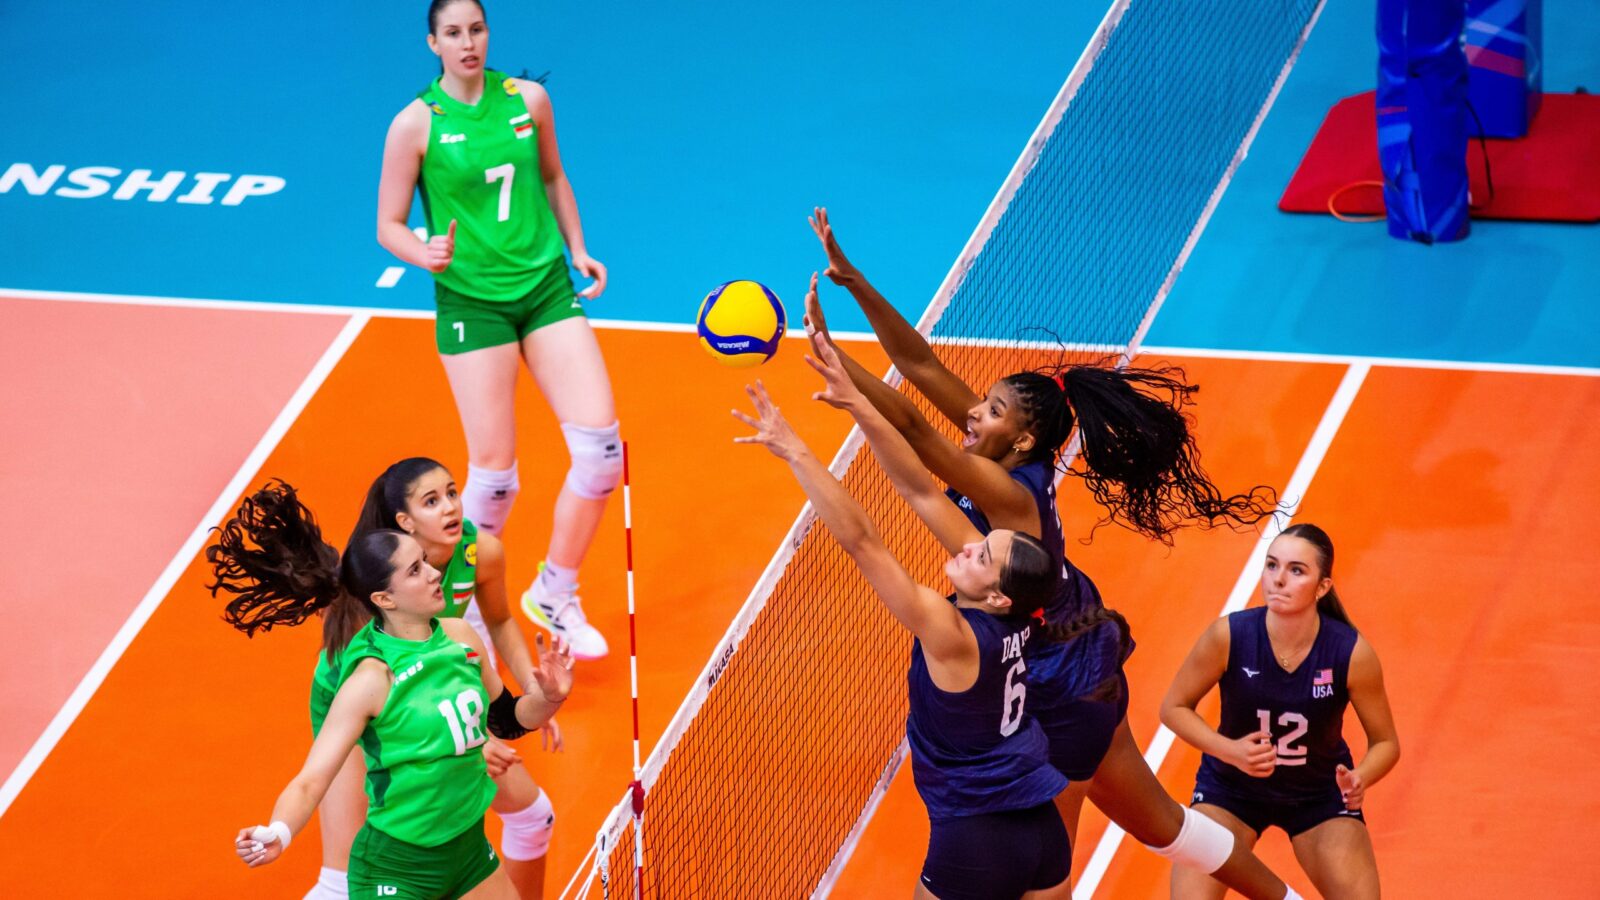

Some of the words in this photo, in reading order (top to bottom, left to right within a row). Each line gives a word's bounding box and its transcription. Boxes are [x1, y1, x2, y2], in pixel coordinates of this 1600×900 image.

[0, 163, 286, 206] NSHIP
[485, 163, 516, 222] 7
[452, 321, 465, 343] 7
[1000, 657, 1027, 738] 6
[1313, 684, 1334, 699] USA
[437, 688, 485, 756] 18
[1256, 709, 1309, 756] 12
